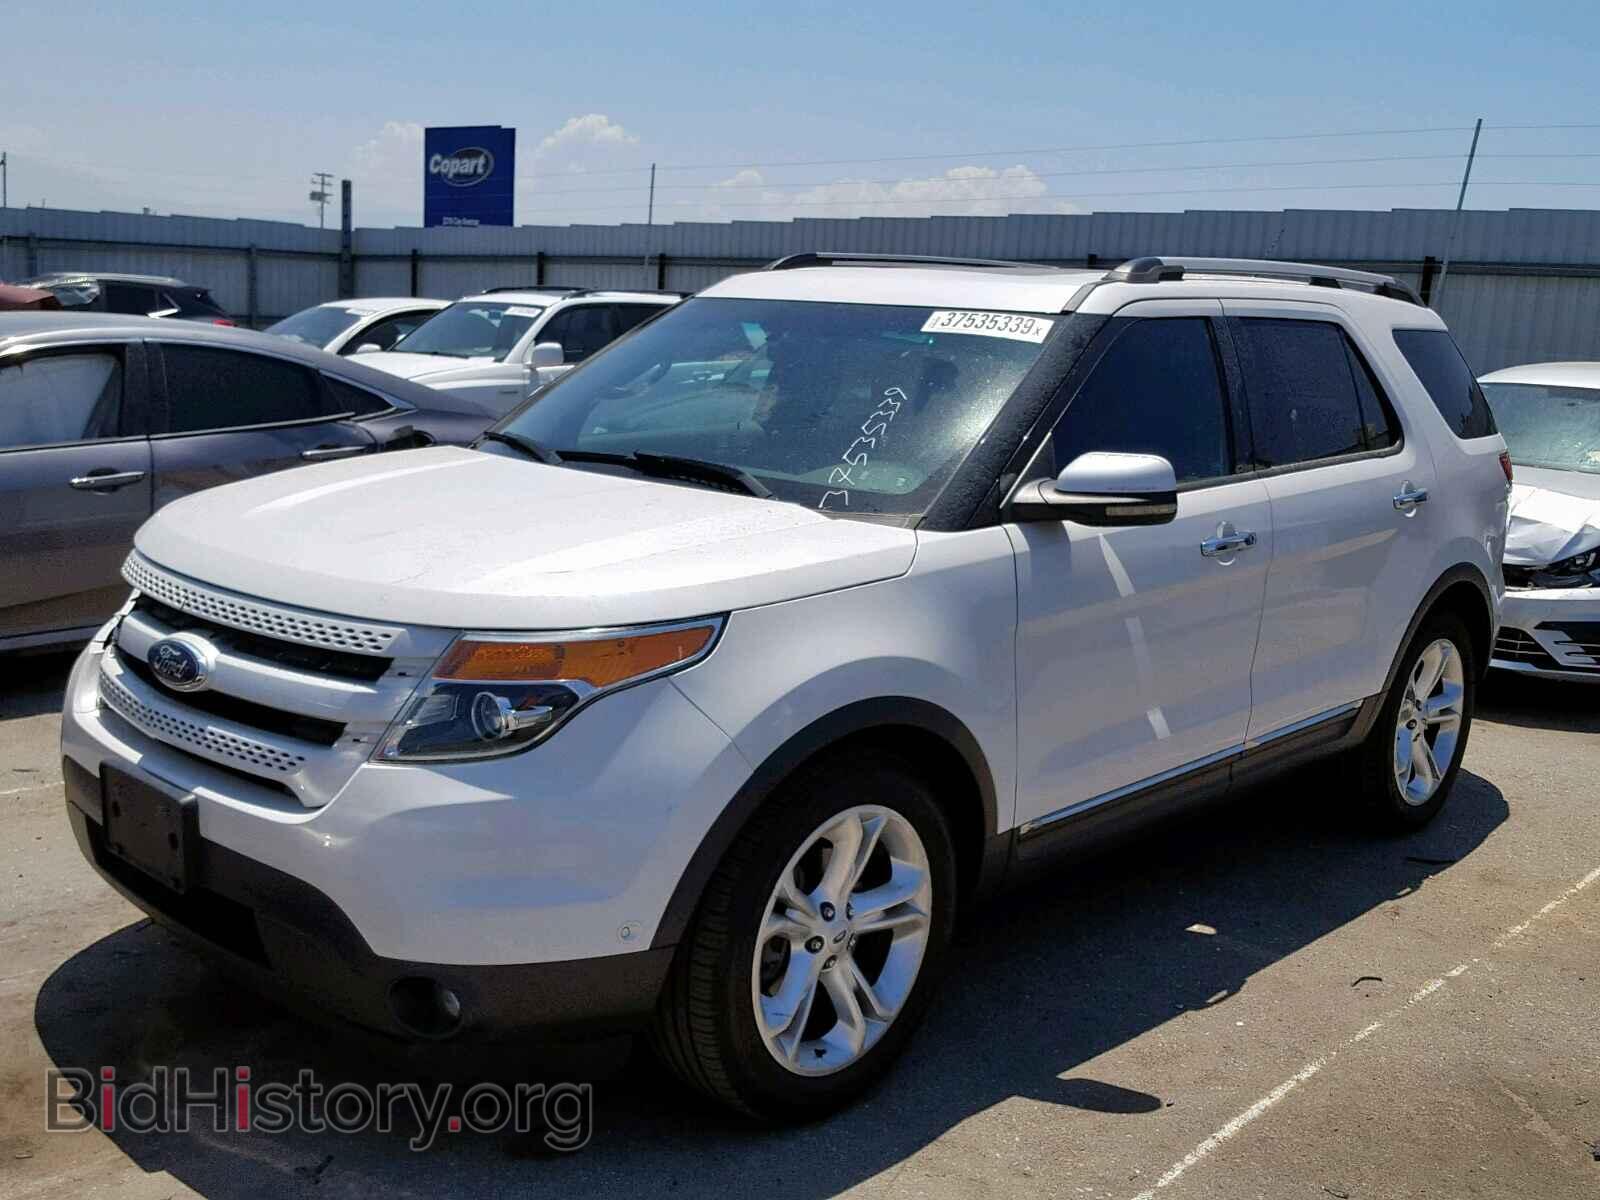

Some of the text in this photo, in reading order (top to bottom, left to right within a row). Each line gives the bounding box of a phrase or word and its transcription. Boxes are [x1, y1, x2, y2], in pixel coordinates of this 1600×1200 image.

[430, 154, 486, 179] Copart
[941, 312, 1036, 335] 37535339
[818, 387, 908, 509] 37535339
[153, 645, 189, 678] Ford
